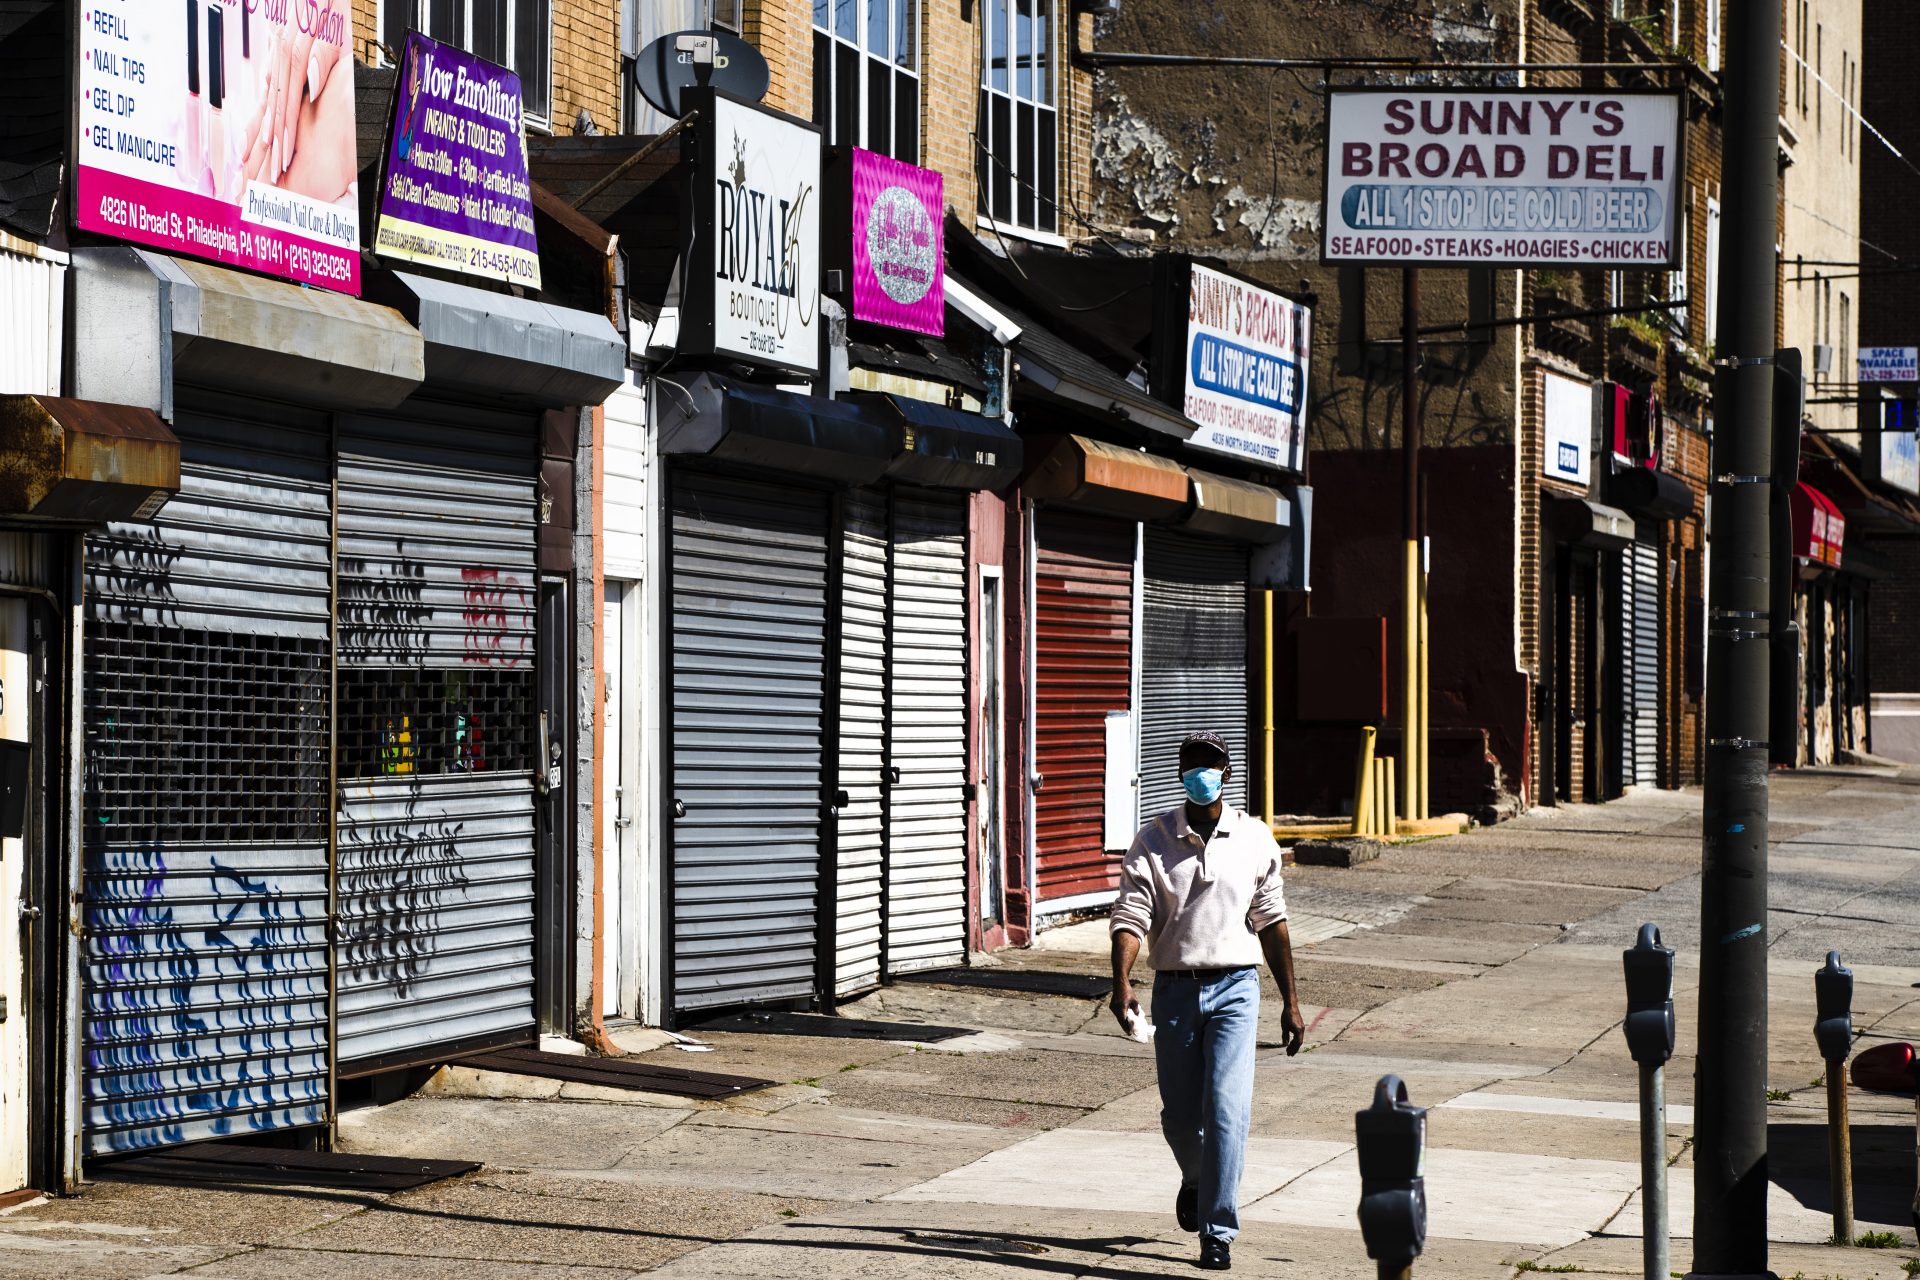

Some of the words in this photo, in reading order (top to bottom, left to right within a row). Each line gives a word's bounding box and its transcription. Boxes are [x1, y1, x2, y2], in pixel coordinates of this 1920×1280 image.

[94, 10, 129, 41] REFILL
[94, 48, 119, 76] NAIL
[122, 57, 145, 84] TIPS
[93, 87, 113, 113] GEL
[117, 94, 135, 118] DIP
[422, 53, 454, 101] Now
[453, 65, 517, 134] Enrolling
[424, 107, 458, 142] INFANTS
[457, 118, 466, 144] &
[466, 120, 506, 158] TODDLERS
[1384, 99, 1625, 137] SUNNY'S
[93, 125, 113, 151] GEL
[117, 131, 176, 167] MANICURE
[1342, 142, 1526, 179] BROAD
[1547, 145, 1665, 182] DELI
[423, 181, 461, 215] Classrooms
[1355, 189, 1396, 226] ALL
[1404, 189, 1413, 226] 1
[1419, 189, 1476, 228] STOP
[1482, 189, 1517, 228] ICE
[1524, 190, 1583, 228] COLD
[1591, 191, 1648, 229] BEER
[248, 189, 292, 225] Professional
[293, 202, 307, 230] Nail
[308, 206, 324, 233] Care
[324, 211, 331, 236] &
[332, 213, 355, 247] Design
[100, 195, 127, 226] 4826
[129, 202, 138, 228] N
[139, 204, 169, 236] Broad
[170, 212, 184, 243] St,
[186, 215, 239, 256] Philadelphia,
[239, 230, 253, 257] PA
[254, 234, 283, 265] 19141
[289, 243, 311, 279] (215)
[311, 251, 351, 282] 329-0264
[717, 178, 795, 298] ROYAL
[1331, 236, 1413, 256] SEAFOOD
[1423, 238, 1493, 257] STEAKS
[1504, 239, 1580, 258] HOAGIES
[1591, 240, 1669, 260] CHICKEN
[730, 290, 775, 327] BOUTIQUE
[1189, 270, 1242, 336] SUNNY'S
[1246, 292, 1286, 348] BROAD
[1200, 339, 1216, 382] ALL
[1217, 344, 1223, 385] 1
[1223, 346, 1243, 391] STOP
[1243, 353, 1257, 395] ICE
[1257, 358, 1280, 401] COLD
[1280, 365, 1295, 406] BEE
[1860, 358, 1916, 368] AVAILABLE
[1871, 349, 1905, 358] SPACE
[1220, 405, 1245, 432] STEAKS
[1247, 412, 1277, 439] HOAGIES
[1225, 436, 1242, 451] NORTH
[1243, 440, 1260, 455] BROAD
[1261, 445, 1279, 459] STREET
